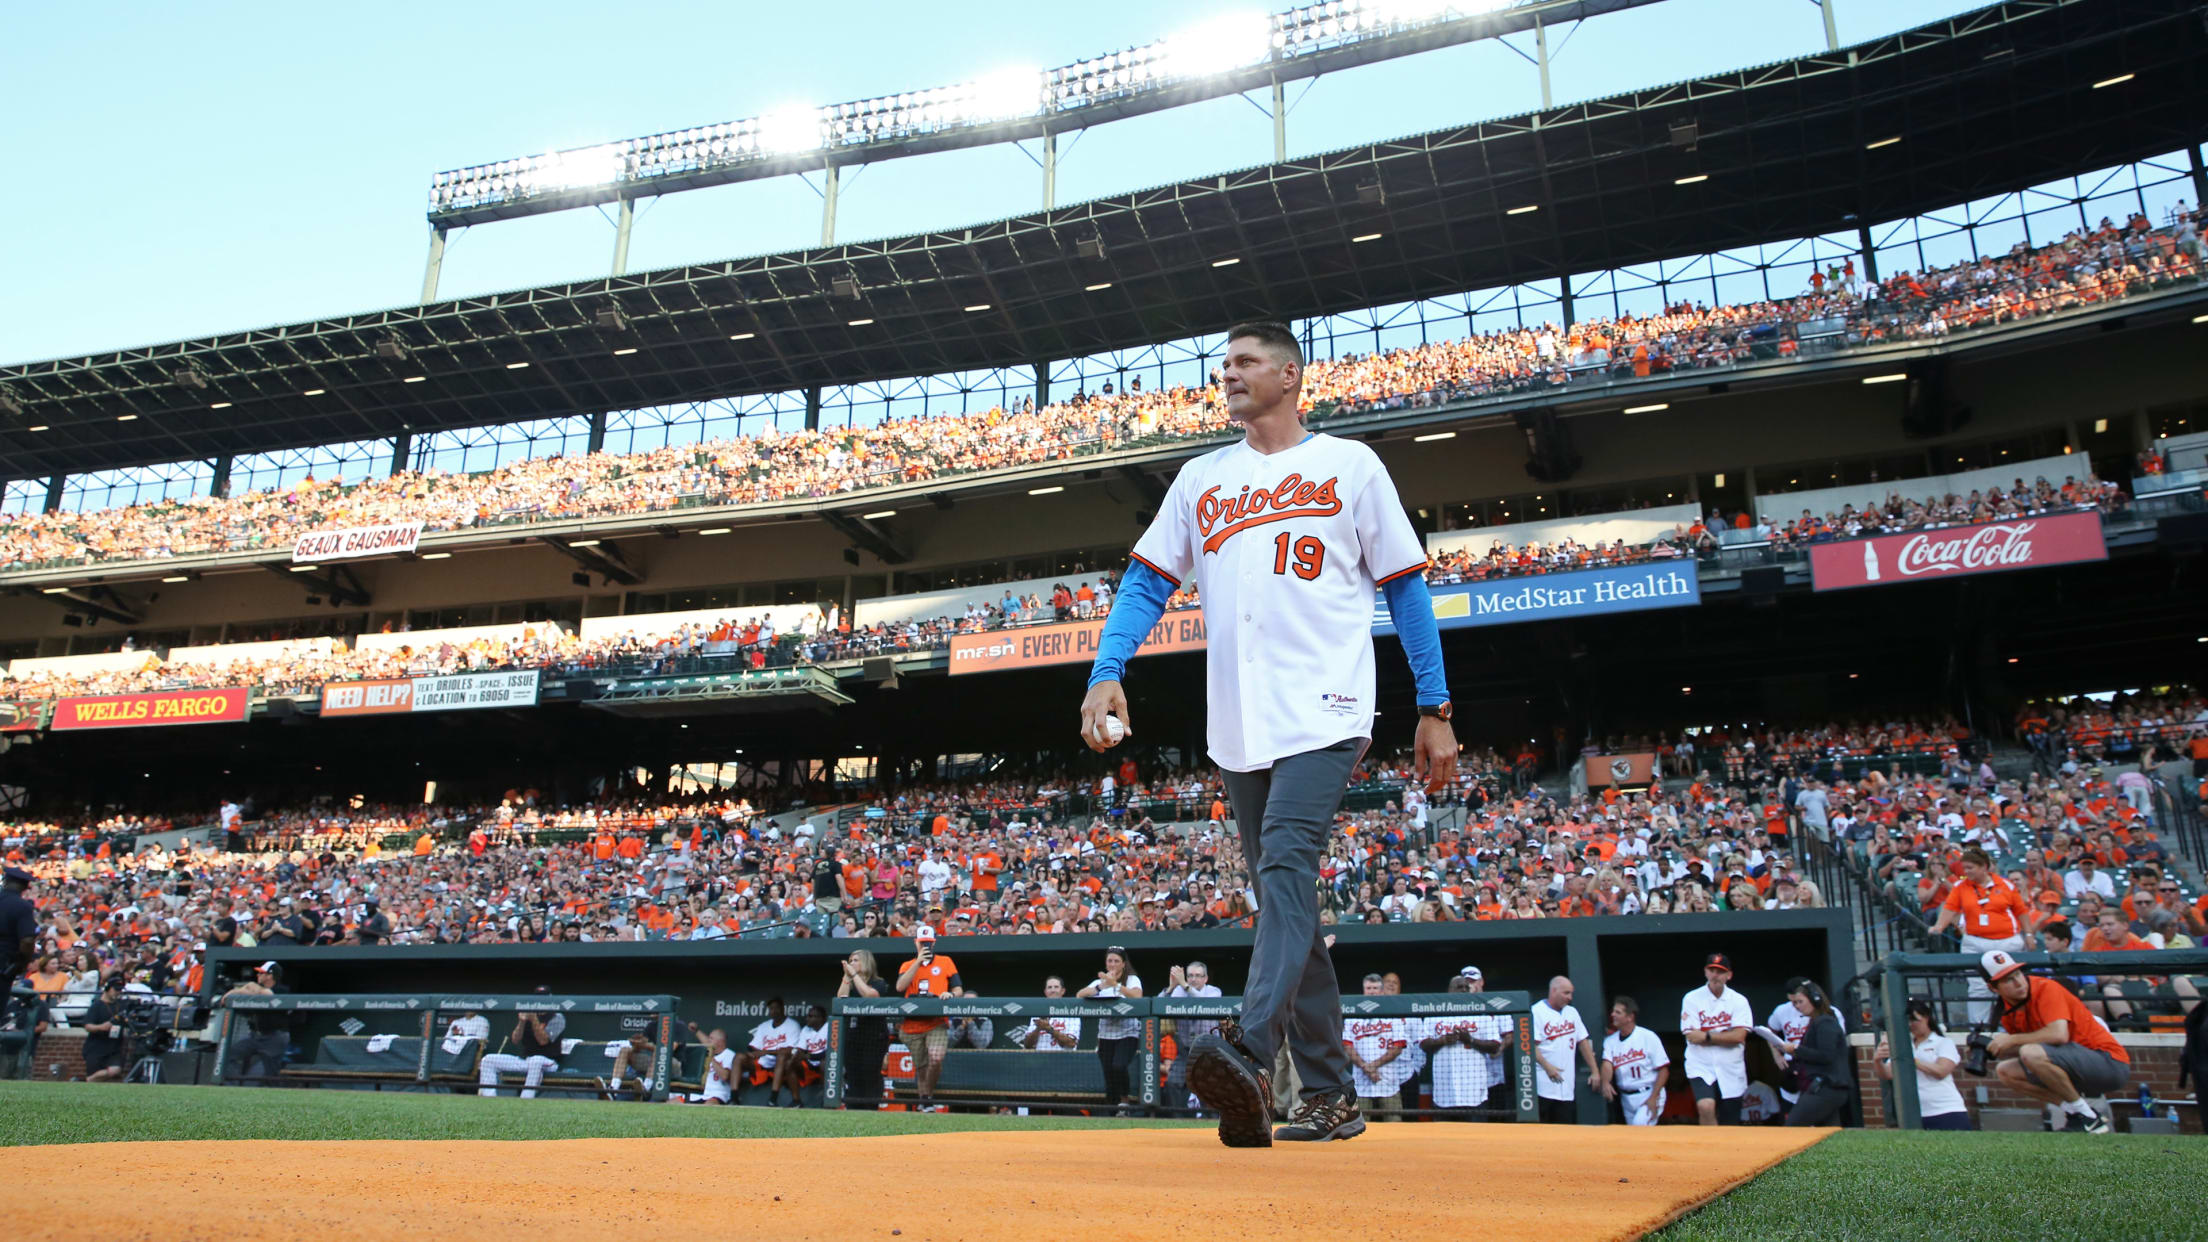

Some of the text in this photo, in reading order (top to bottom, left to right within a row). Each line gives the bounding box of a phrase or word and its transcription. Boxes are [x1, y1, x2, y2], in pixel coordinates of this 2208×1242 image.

[1196, 472, 1343, 537] Orioles
[296, 527, 418, 556] GEAUX GAUSMAN
[1897, 522, 2037, 576] Coca-Cola
[1273, 531, 1326, 581] 19
[1475, 572, 1690, 616] MedStar Health
[1022, 631, 1072, 659] EVERY
[1077, 628, 1101, 652] PL
[436, 677, 473, 691] ORIOLES
[507, 674, 535, 687] ISSUE
[75, 696, 227, 722] WELLS FARGO
[326, 684, 411, 710] NEED HELP?
[421, 691, 466, 705] LOCATION
[479, 689, 510, 702] 69050
[715, 1001, 749, 1017] Bank
[750, 1001, 764, 1017] of
[842, 1005, 860, 1015] Bank
[869, 1005, 899, 1015] America
[943, 1005, 962, 1015] Bank
[971, 1006, 1002, 1016] America
[1049, 1006, 1069, 1015] Bank
[1079, 1006, 1112, 1016] America
[1165, 1005, 1186, 1015] Bank
[1196, 1005, 1232, 1015] America
[1411, 1003, 1435, 1013] Bank
[1446, 1002, 1486, 1012] America
[655, 1016, 670, 1091] Orioles.com
[1569, 1037, 1575, 1050] 3
[826, 1020, 840, 1099] Orioles.com
[900, 1055, 914, 1073] G
[1143, 1019, 1154, 1104] Orioles.com
[1520, 1017, 1534, 1111] Orioles.com
[1630, 1065, 1641, 1079] 11
